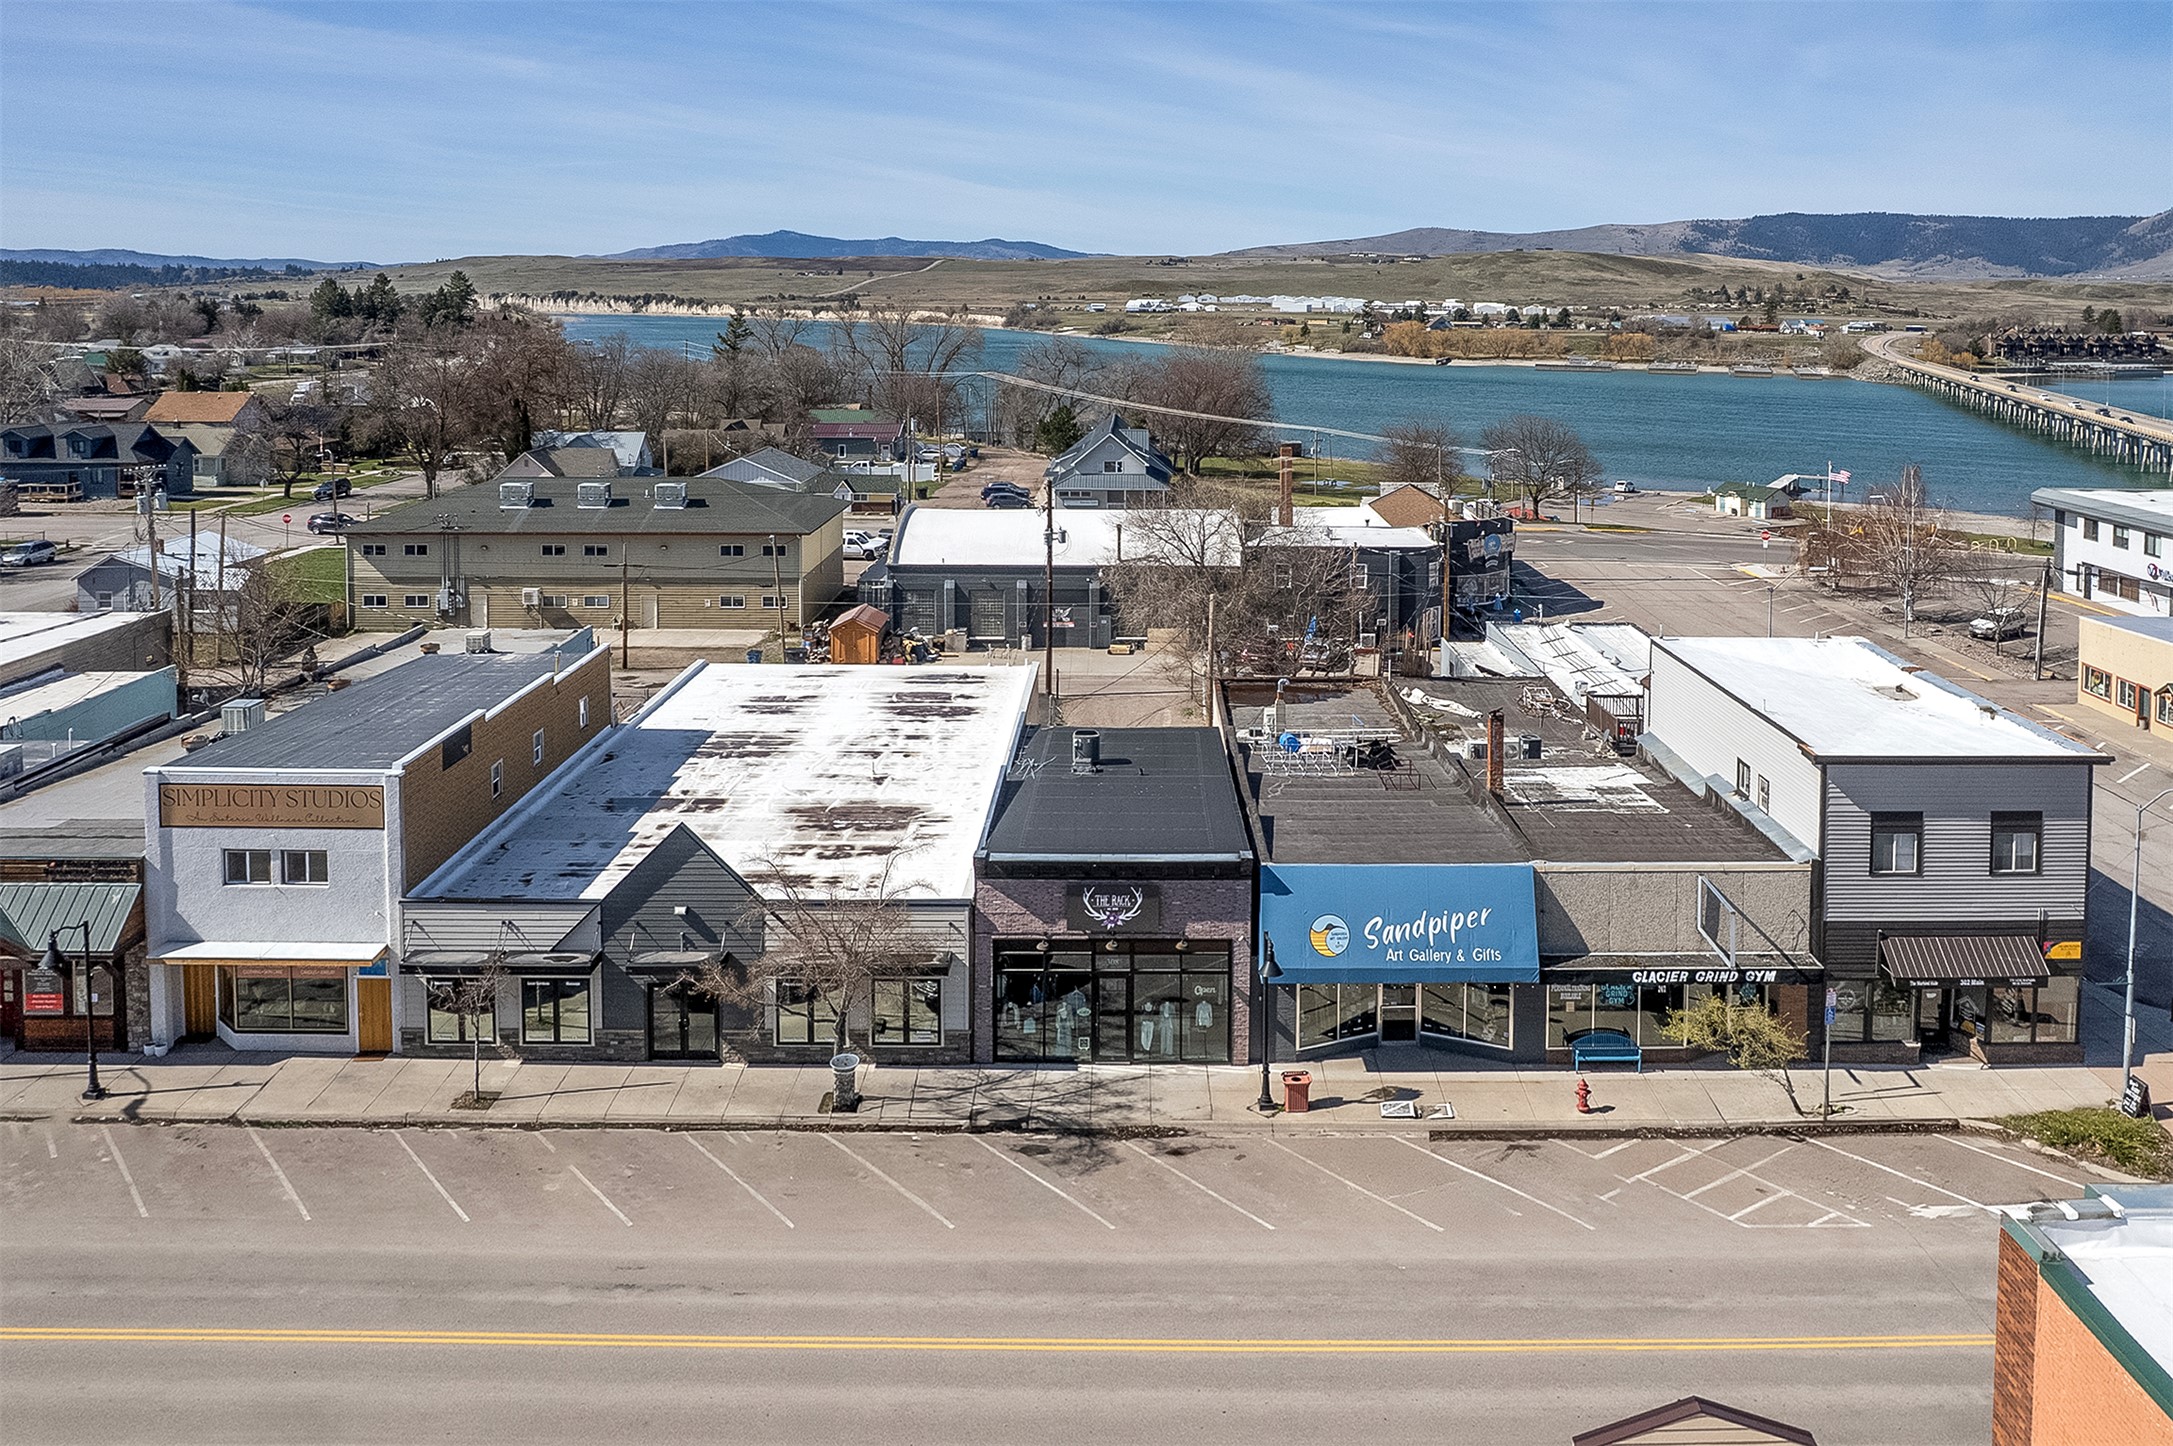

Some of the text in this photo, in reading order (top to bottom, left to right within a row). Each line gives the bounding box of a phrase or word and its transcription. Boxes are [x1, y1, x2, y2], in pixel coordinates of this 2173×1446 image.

[162, 788, 382, 809] SIMPLICITY STUDIOS
[255, 813, 303, 823] Wellness
[304, 812, 359, 824] Collective
[1094, 894, 1131, 906] THE RACK
[1363, 907, 1492, 950] Sandpiper
[1385, 947, 1502, 964] Art Gallery & Gifts
[1632, 970, 1777, 983] GLACIER GRIND GYM
[1194, 985, 1217, 997] Open
[1605, 990, 1628, 998] GRIND
[1608, 997, 1625, 1005] GYM
